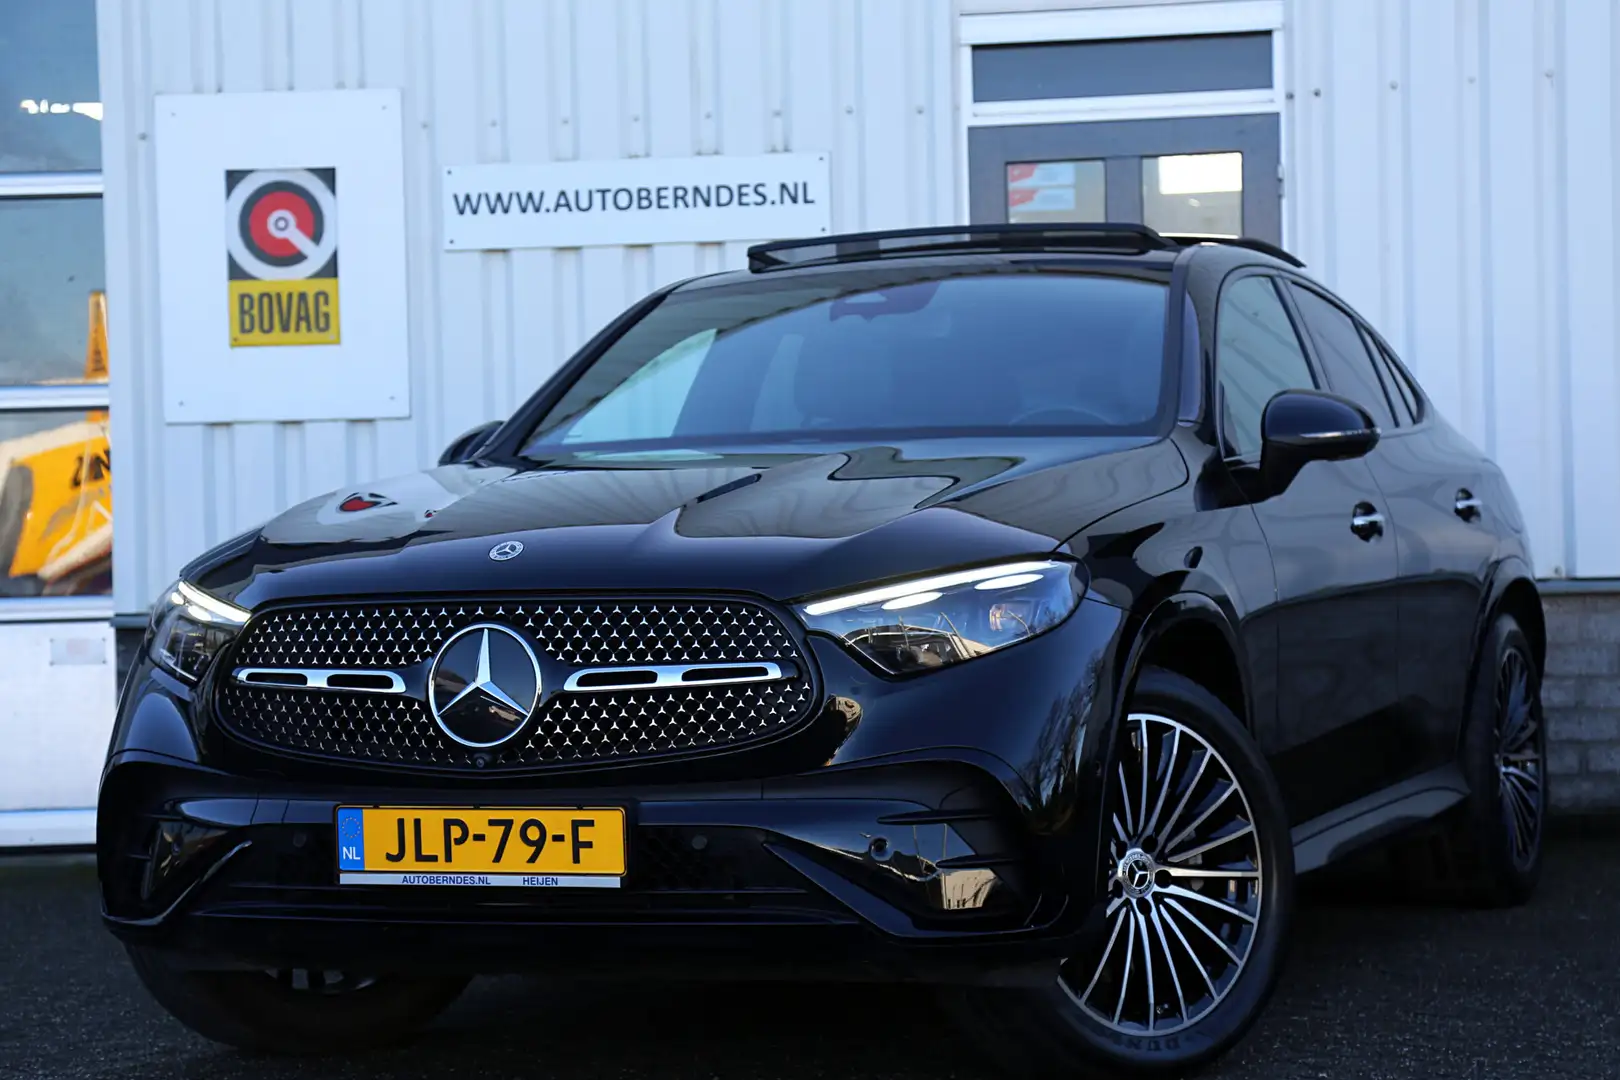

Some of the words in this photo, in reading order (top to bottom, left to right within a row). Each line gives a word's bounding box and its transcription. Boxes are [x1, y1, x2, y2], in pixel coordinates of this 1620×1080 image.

[453, 181, 814, 215] WWW.AUTOBERNDES.NL
[238, 290, 331, 334] BOVAG
[343, 846, 361, 860] NL
[385, 817, 595, 864] JLP-79-F
[401, 875, 491, 886] AUTOBERNDES.NL
[522, 876, 558, 886] HEIJEN
